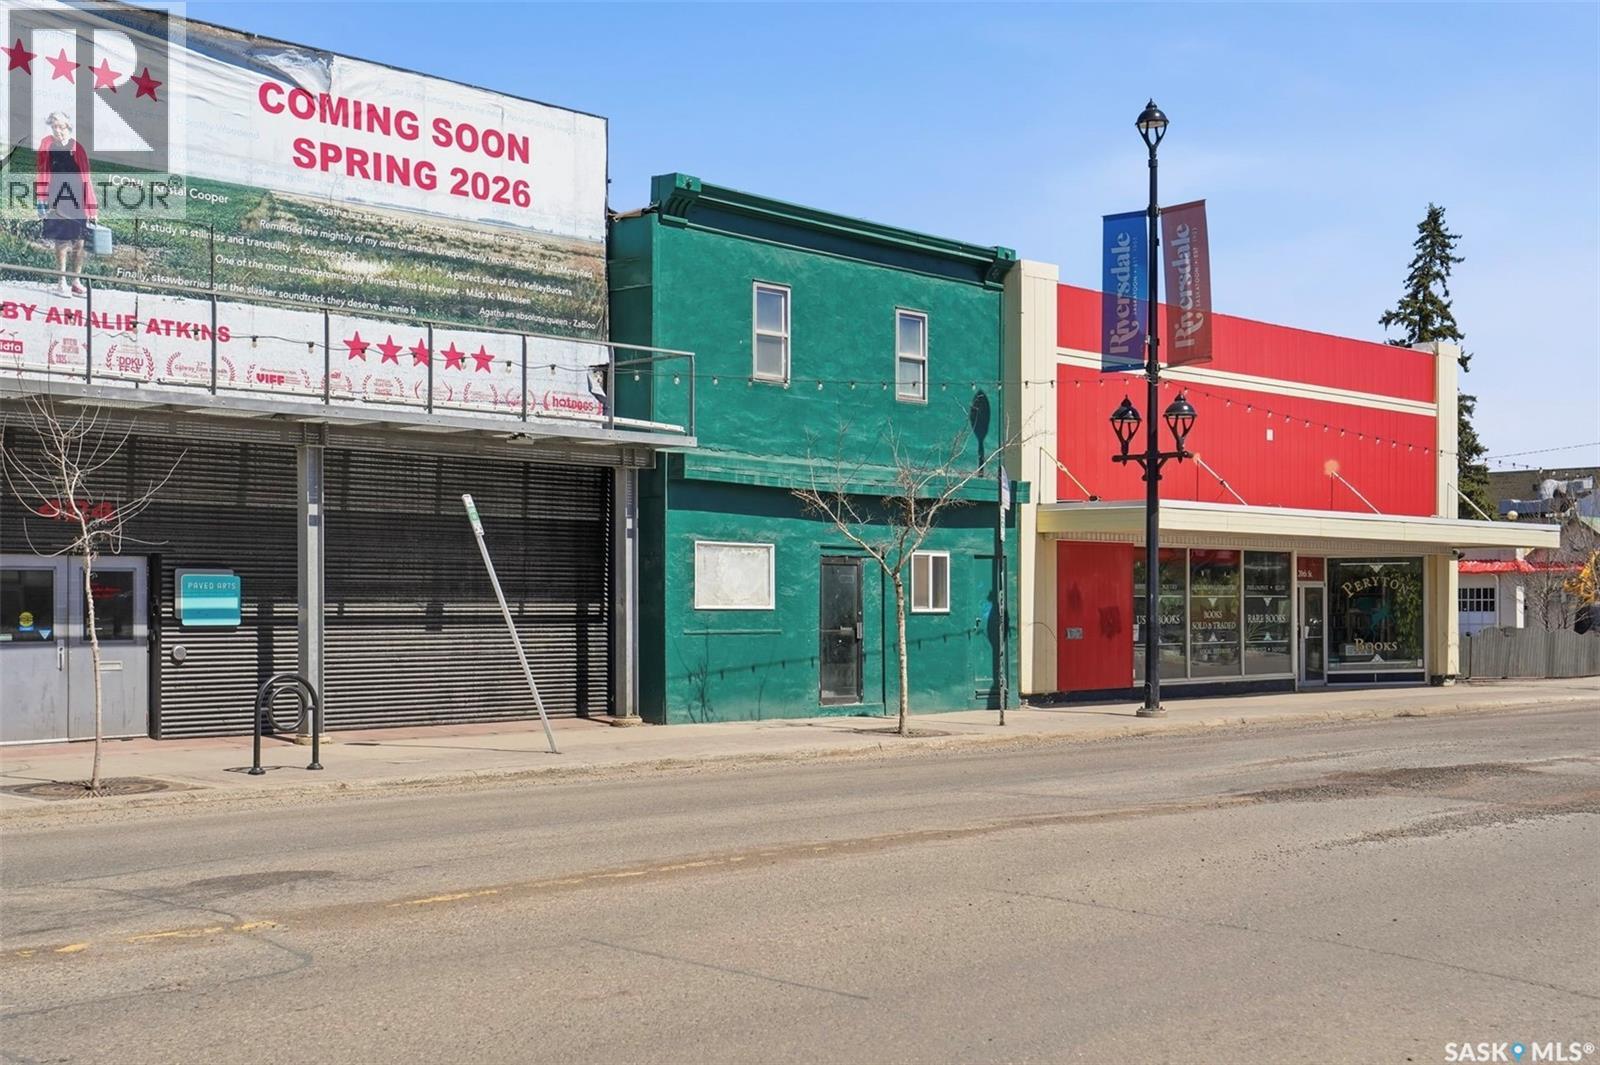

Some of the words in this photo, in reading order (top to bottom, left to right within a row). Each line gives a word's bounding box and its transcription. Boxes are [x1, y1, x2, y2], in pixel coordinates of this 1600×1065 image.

[258, 81, 420, 141] COMING
[431, 117, 530, 164] SOON
[292, 137, 437, 191] SPRING
[450, 167, 531, 208] 2026
[189, 188, 230, 205] Cooper
[140, 221, 148, 231] A
[150, 225, 177, 237] study
[180, 228, 188, 236] in
[228, 235, 245, 245] and
[301, 244, 358, 261] FolkestoneDE
[260, 220, 303, 235] Reminded
[305, 229, 319, 237] me
[320, 230, 353, 244] mightily
[355, 235, 365, 244] of
[365, 239, 379, 248] my
[380, 241, 397, 249] own
[215, 253, 236, 266] One
[237, 257, 248, 267] of
[248, 258, 264, 269] the
[266, 263, 288, 273] most
[289, 266, 364, 284] uncompromisingly
[366, 273, 398, 287] feminist
[399, 277, 417, 289] films
[419, 281, 427, 291] of
[428, 283, 440, 292] the
[447, 271, 454, 279] A
[454, 273, 481, 284] perfect
[483, 276, 499, 286] slice
[508, 278, 519, 288] life
[116, 267, 149, 283] Finally,
[152, 273, 210, 289] strawberries
[212, 282, 227, 292] get
[230, 283, 245, 293] the
[247, 285, 276, 298] slasher
[279, 291, 325, 304] soundtrack
[327, 296, 346, 308] they
[348, 297, 381, 311] deserve.
[388, 304, 409, 314] annie
[411, 304, 418, 314] b
[1109, 231, 1140, 354] Riversdale
[1171, 223, 1203, 349] Riversdale
[3, 301, 37, 321] BY
[45, 306, 137, 332] AMALIE
[146, 318, 231, 342] ATKINS
[479, 307, 505, 319] Agatha
[506, 311, 516, 319] an
[516, 311, 546, 323] absolute
[547, 317, 569, 327] queen
[256, 373, 286, 385] VIFF
[187, 582, 214, 590] PAVED
[217, 582, 237, 590] ARTS
[1342, 576, 1410, 598] PERYTON
[1203, 610, 1223, 619] BOOKS
[1247, 614, 1264, 623] RARE
[1265, 614, 1287, 624] BOOKS
[1191, 622, 1208, 630] SOLD
[1213, 622, 1237, 630] TRADED
[1353, 638, 1398, 651] BOOKS
